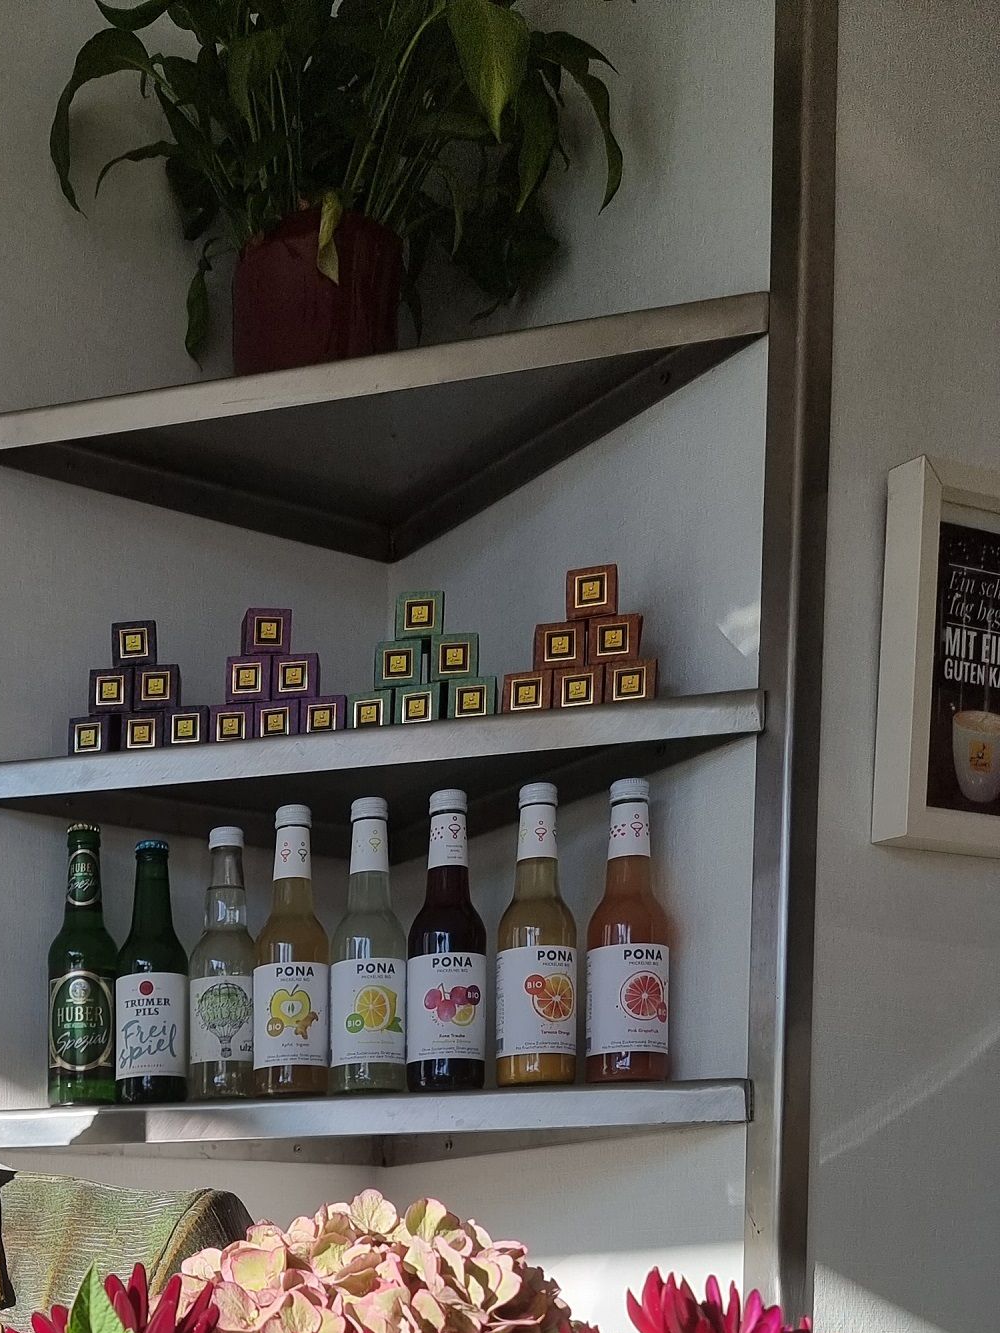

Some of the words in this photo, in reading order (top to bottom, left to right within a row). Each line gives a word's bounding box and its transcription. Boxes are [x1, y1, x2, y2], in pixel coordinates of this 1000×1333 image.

[949, 570, 975, 594] Ein
[948, 592, 974, 622] Tag
[945, 626, 977, 660] MIT
[944, 658, 986, 686] GUTEN
[537, 950, 573, 962] PONA
[624, 949, 663, 961] PONA
[432, 956, 472, 968] PONA
[276, 966, 315, 977] PONA
[356, 963, 395, 974] PONA
[527, 981, 543, 989] BIO
[467, 991, 480, 999] BIO
[124, 998, 171, 1008] TRUMER
[57, 1005, 104, 1027] HUBER
[135, 1007, 160, 1017] PILS
[268, 1023, 282, 1031] BIO
[347, 1019, 362, 1028] BIO
[121, 1019, 167, 1049] Frei
[56, 1028, 107, 1057] Spezial
